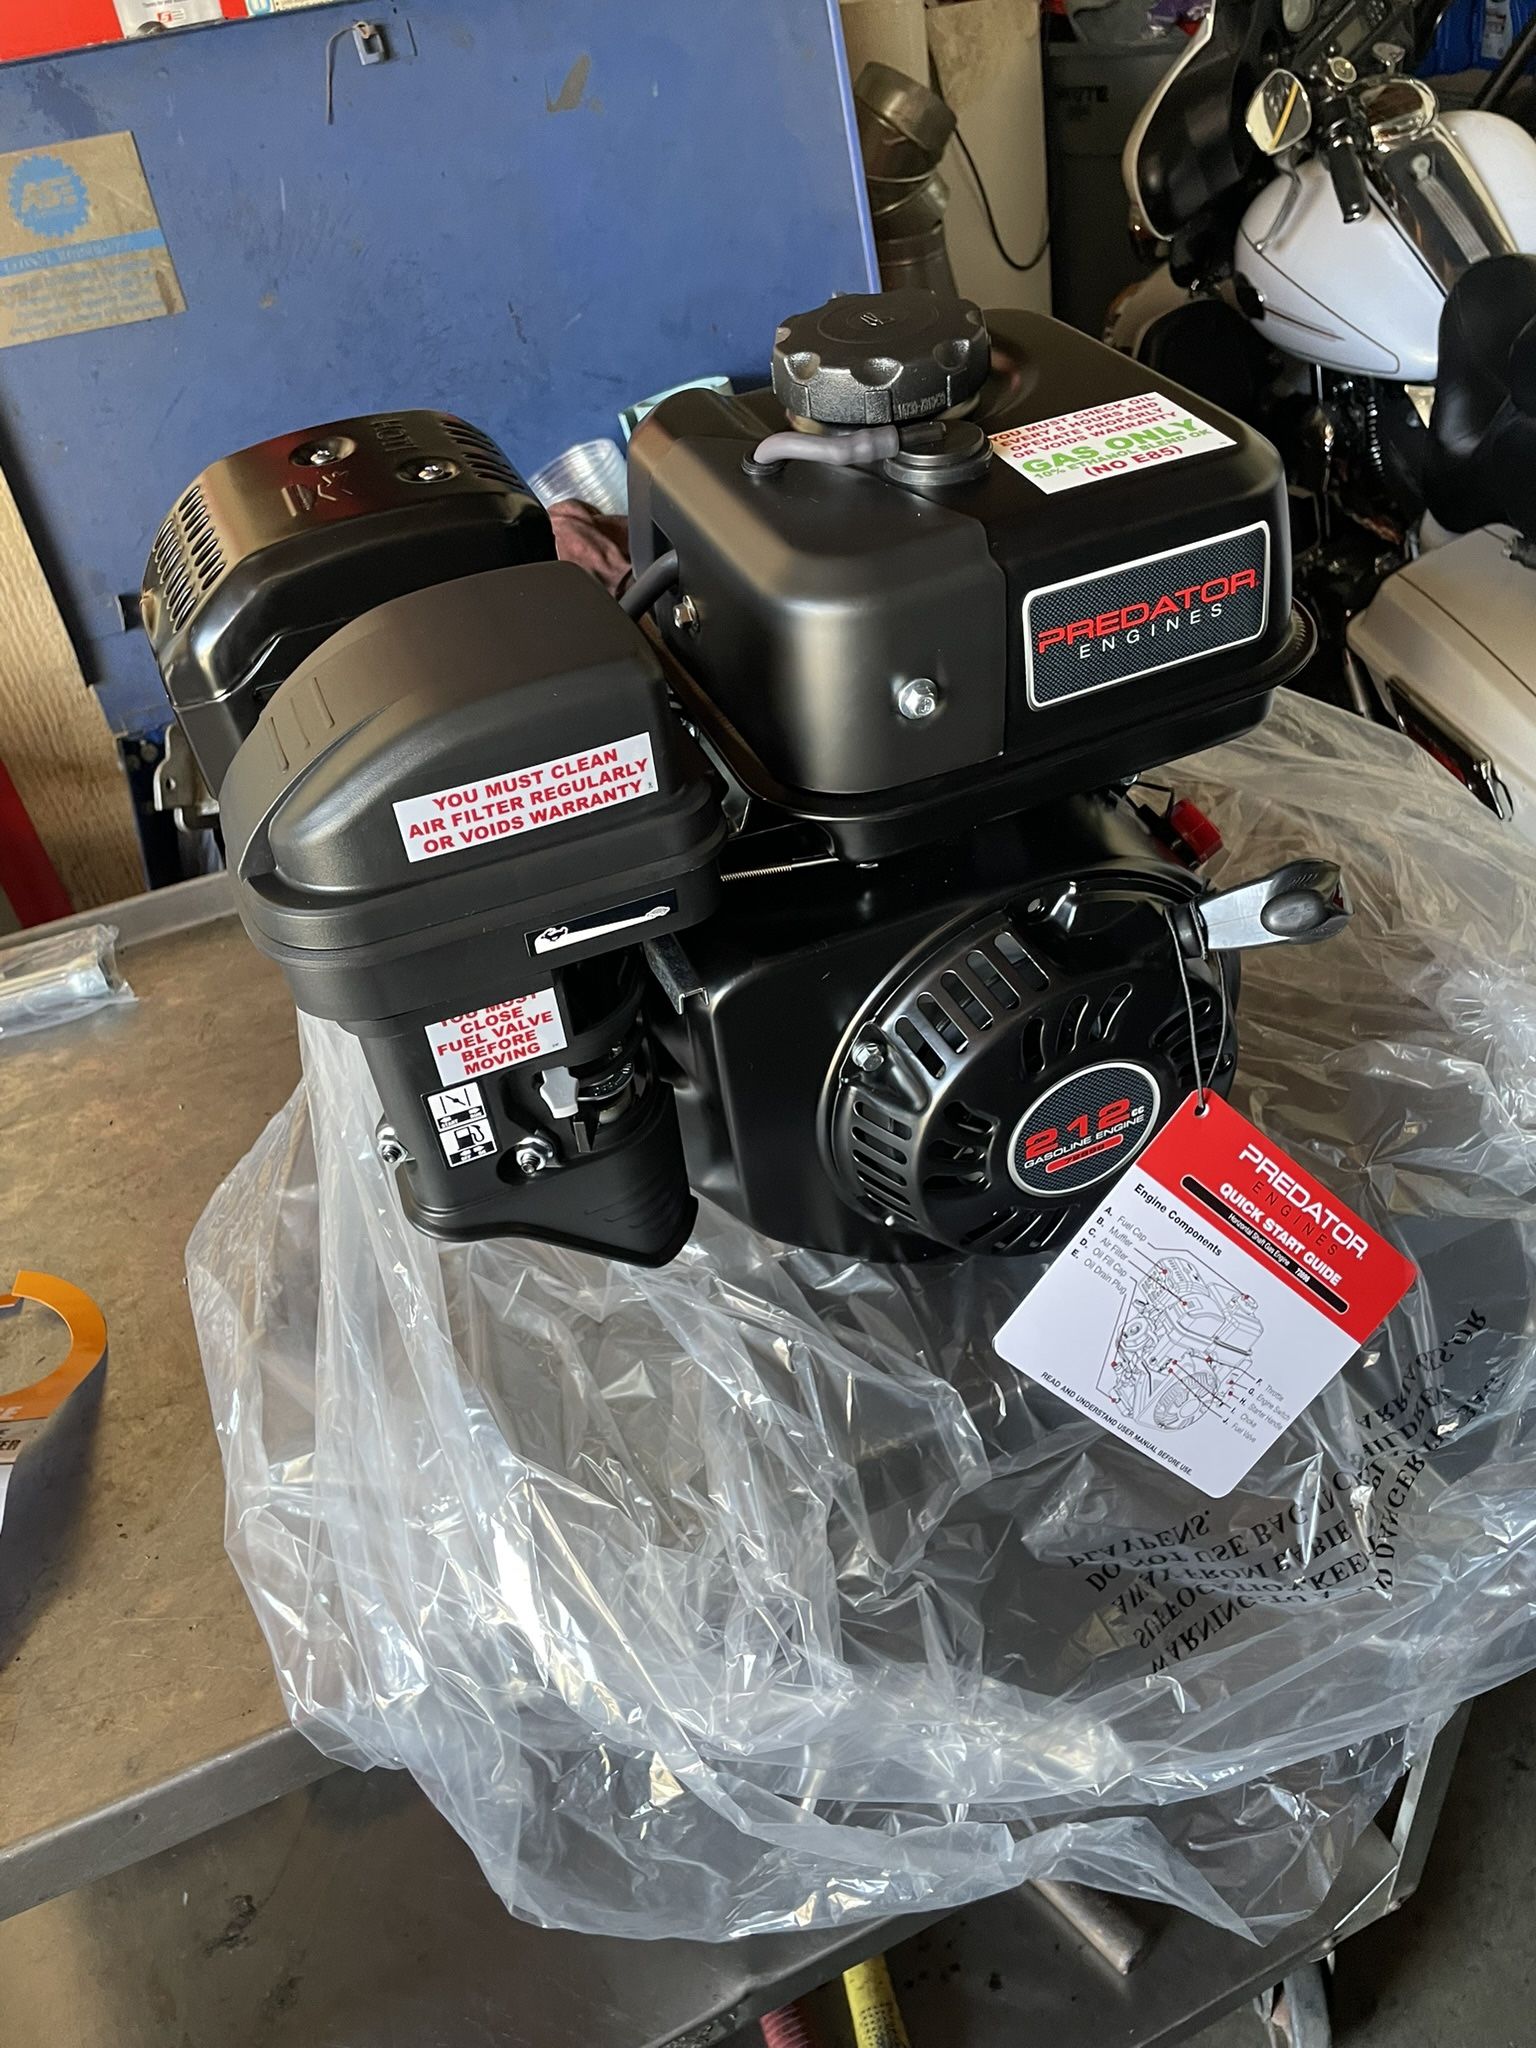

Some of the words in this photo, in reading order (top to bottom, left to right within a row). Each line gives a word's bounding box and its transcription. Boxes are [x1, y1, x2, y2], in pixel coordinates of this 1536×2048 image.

[992, 430, 1021, 442] YOU
[1025, 417, 1067, 432] MUST
[1073, 403, 1126, 419] CHECK
[1129, 396, 1156, 405] OIL
[1000, 429, 1050, 447] EVERY
[1069, 411, 1123, 428] HOURS
[1127, 401, 1158, 413] AND
[1010, 429, 1083, 452] OPERATE
[1085, 408, 1163, 431] PROPERLY
[1013, 449, 1037, 458] OR
[1039, 435, 1088, 451] VOIDS
[1090, 411, 1177, 437] WARRANTY
[1022, 446, 1099, 474] GAS
[1105, 418, 1197, 450] ONLY
[1034, 468, 1067, 479] 10%
[1068, 449, 1138, 471] ETHANOL
[1139, 435, 1187, 451] BLEND
[1189, 429, 1212, 438] OK
[1085, 459, 1128, 477] (NO
[1131, 445, 1183, 464] E85)
[1038, 568, 1258, 654] PREDATOR
[1079, 603, 1222, 660] ENGINES
[409, 818, 447, 839] AIR
[451, 796, 525, 828] FILTER
[529, 758, 648, 806] REGULARLY
[432, 788, 479, 812] YOU
[484, 770, 544, 798] MUST
[551, 748, 619, 779] CLEAN
[423, 835, 455, 854] OR
[459, 816, 524, 844] VOIDS
[529, 779, 642, 824] WARRANTY
[436, 1033, 488, 1057] FUEL
[491, 1010, 554, 1038] VALVE
[460, 1006, 524, 1035] CLOSE
[461, 1029, 538, 1063] BEFORE
[463, 1042, 541, 1075] MOVING
[1024, 1136, 1092, 1169] GASOLINE
[1095, 1114, 1145, 1140] ENGINE
[1025, 1098, 1131, 1160] 212
[1104, 1206, 1113, 1217] A.
[1117, 1215, 1135, 1233] Fuel
[1132, 1226, 1148, 1243] Cap
[1134, 1183, 1168, 1214] Engine
[1168, 1210, 1223, 1257] Components
[1238, 1143, 1370, 1260] PREDATOR
[1252, 1180, 1339, 1256] ENGINES
[1088, 1228, 1096, 1238] C.
[1100, 1237, 1113, 1248] Air
[1111, 1245, 1129, 1262] Filter
[1096, 1217, 1105, 1228] B.
[1108, 1226, 1133, 1247] Muffler
[1219, 1182, 1266, 1223] QUICK
[1262, 1217, 1307, 1255] START
[1302, 1253, 1343, 1287] GUIDE
[1228, 1213, 1254, 1236] Horizontal
[1251, 1232, 1266, 1247] Shaft
[1264, 1242, 1276, 1255] Gas
[1273, 1250, 1290, 1266] Engine
[1071, 1249, 1079, 1259] E.
[1083, 1258, 1095, 1270] Oil
[1093, 1265, 1113, 1283] Drain
[1110, 1278, 1127, 1296] Plug
[1079, 1238, 1088, 1249] D.
[1092, 1247, 1105, 1259] Oil
[1103, 1254, 1114, 1268] Fill
[1112, 1262, 1127, 1278] Cap
[1040, 1371, 1061, 1389] READ
[1060, 1386, 1076, 1400] AND
[1075, 1394, 1118, 1427] UNDERSTAND
[1116, 1422, 1135, 1439] USER
[1134, 1433, 1158, 1454] MANUAL
[1157, 1450, 1181, 1468] BEFORE
[1179, 1464, 1193, 1476] USE.
